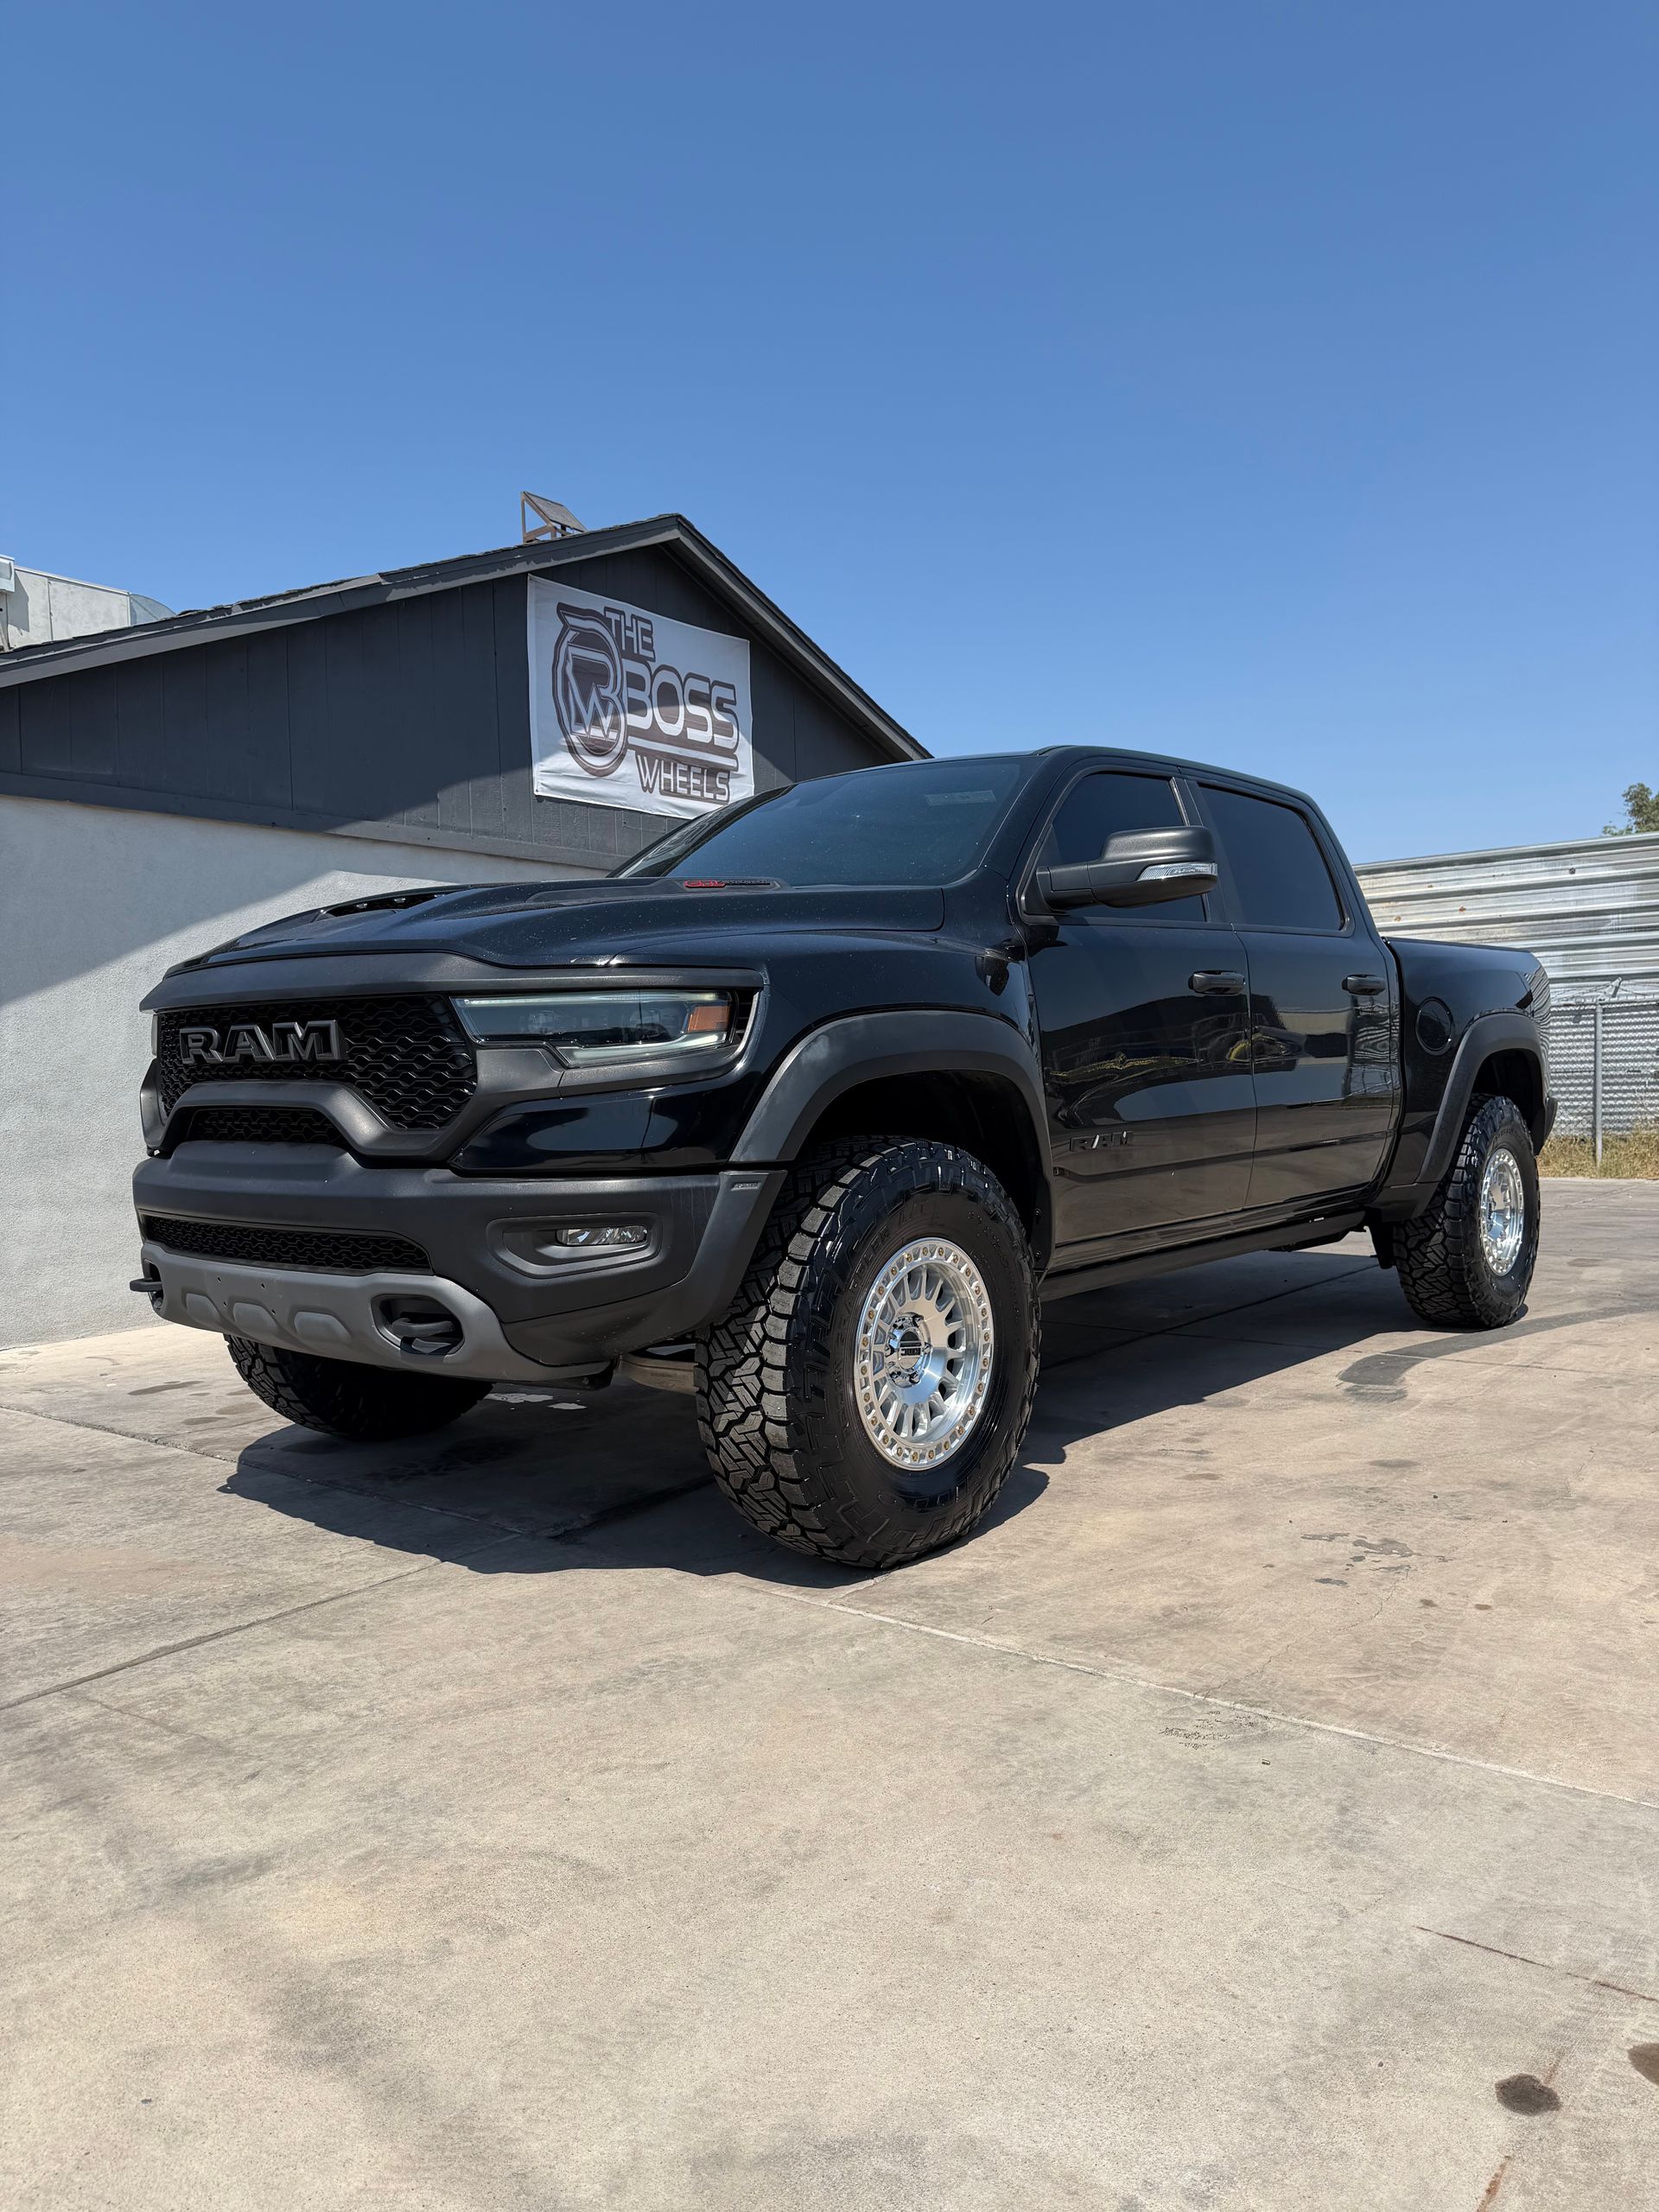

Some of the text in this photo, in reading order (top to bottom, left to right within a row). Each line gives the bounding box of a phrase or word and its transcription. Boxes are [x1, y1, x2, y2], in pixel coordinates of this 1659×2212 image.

[605, 607, 656, 660] THE
[623, 658, 739, 749] BOSS
[636, 753, 731, 804] WHEELS
[179, 1020, 346, 1064] RAM
